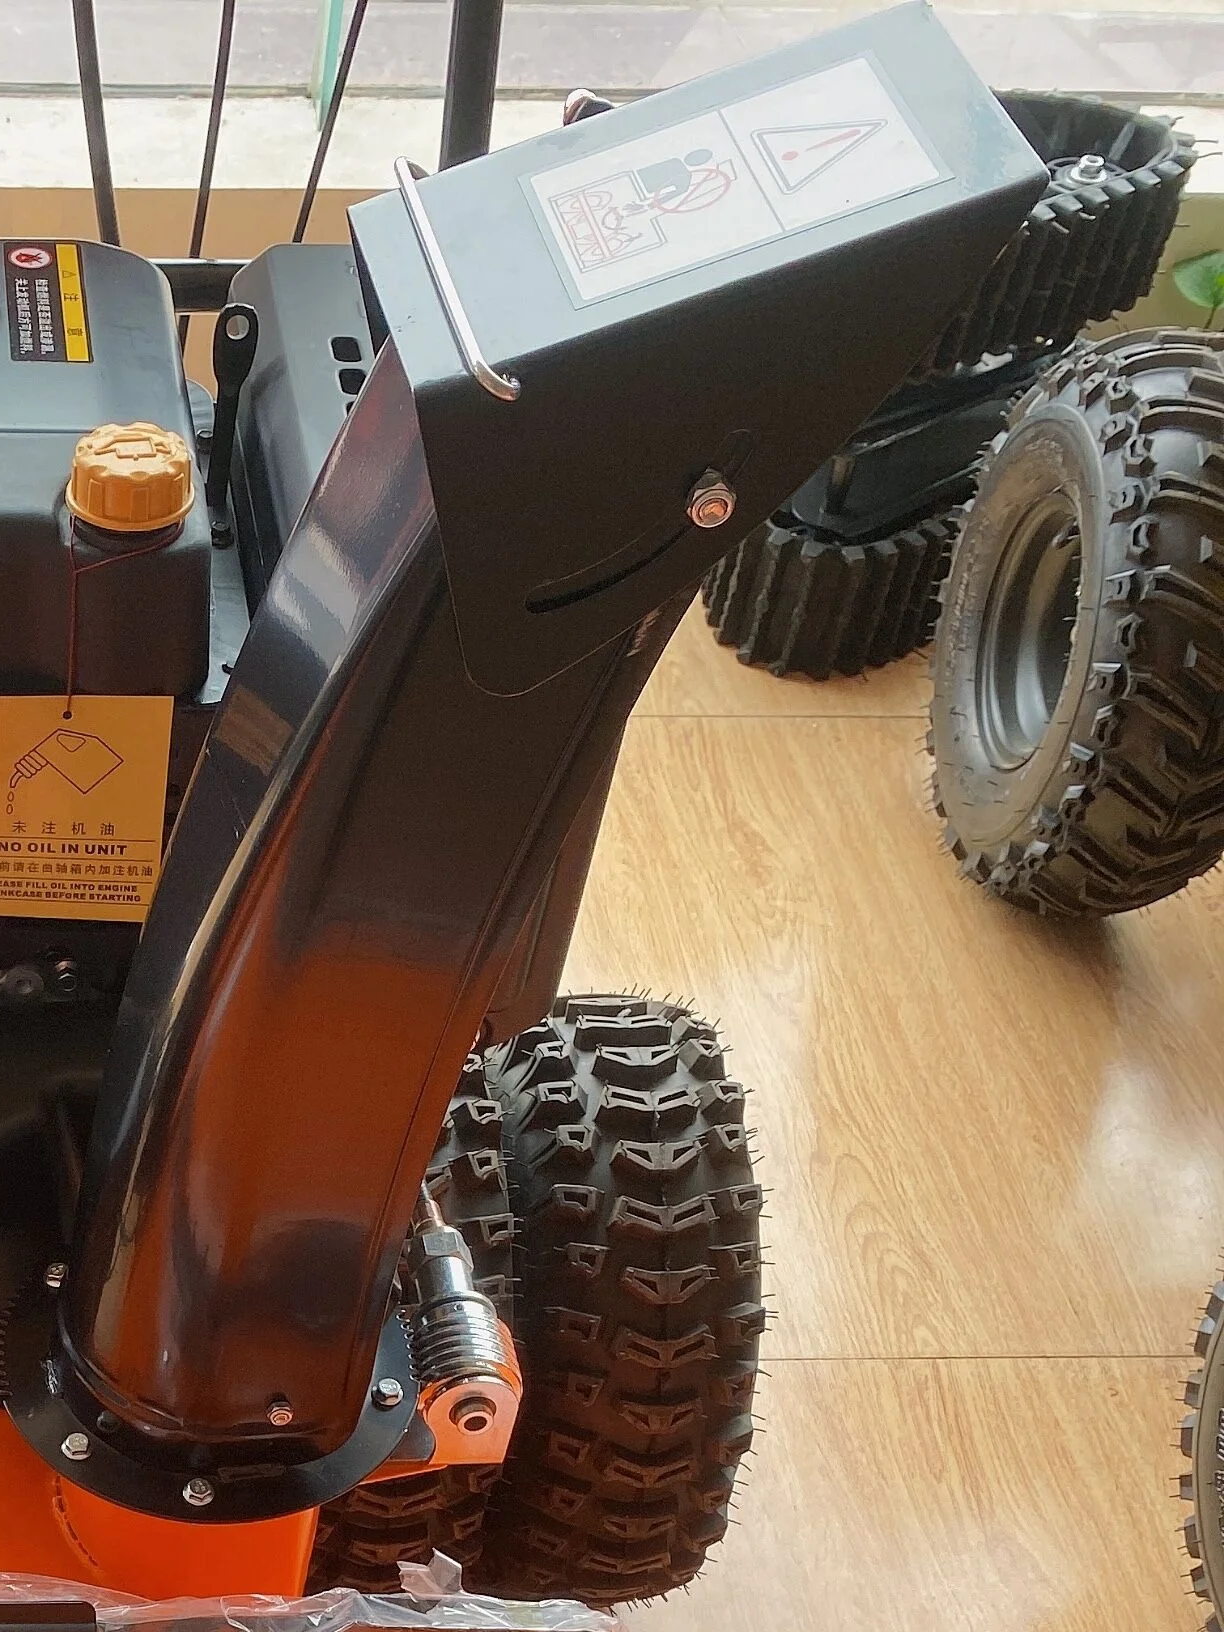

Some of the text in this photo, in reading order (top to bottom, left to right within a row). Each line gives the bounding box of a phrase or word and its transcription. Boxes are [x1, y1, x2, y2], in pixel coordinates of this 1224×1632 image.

[27, 842, 56, 854] OIL
[61, 843, 79, 854] IN
[84, 844, 128, 856] UNIT
[25, 881, 48, 890] FILL
[50, 882, 68, 890] OIL
[70, 882, 95, 891] INTO
[97, 884, 138, 893] ENGINE
[45, 891, 87, 900] BEFORE
[88, 893, 141, 902] STARTING
